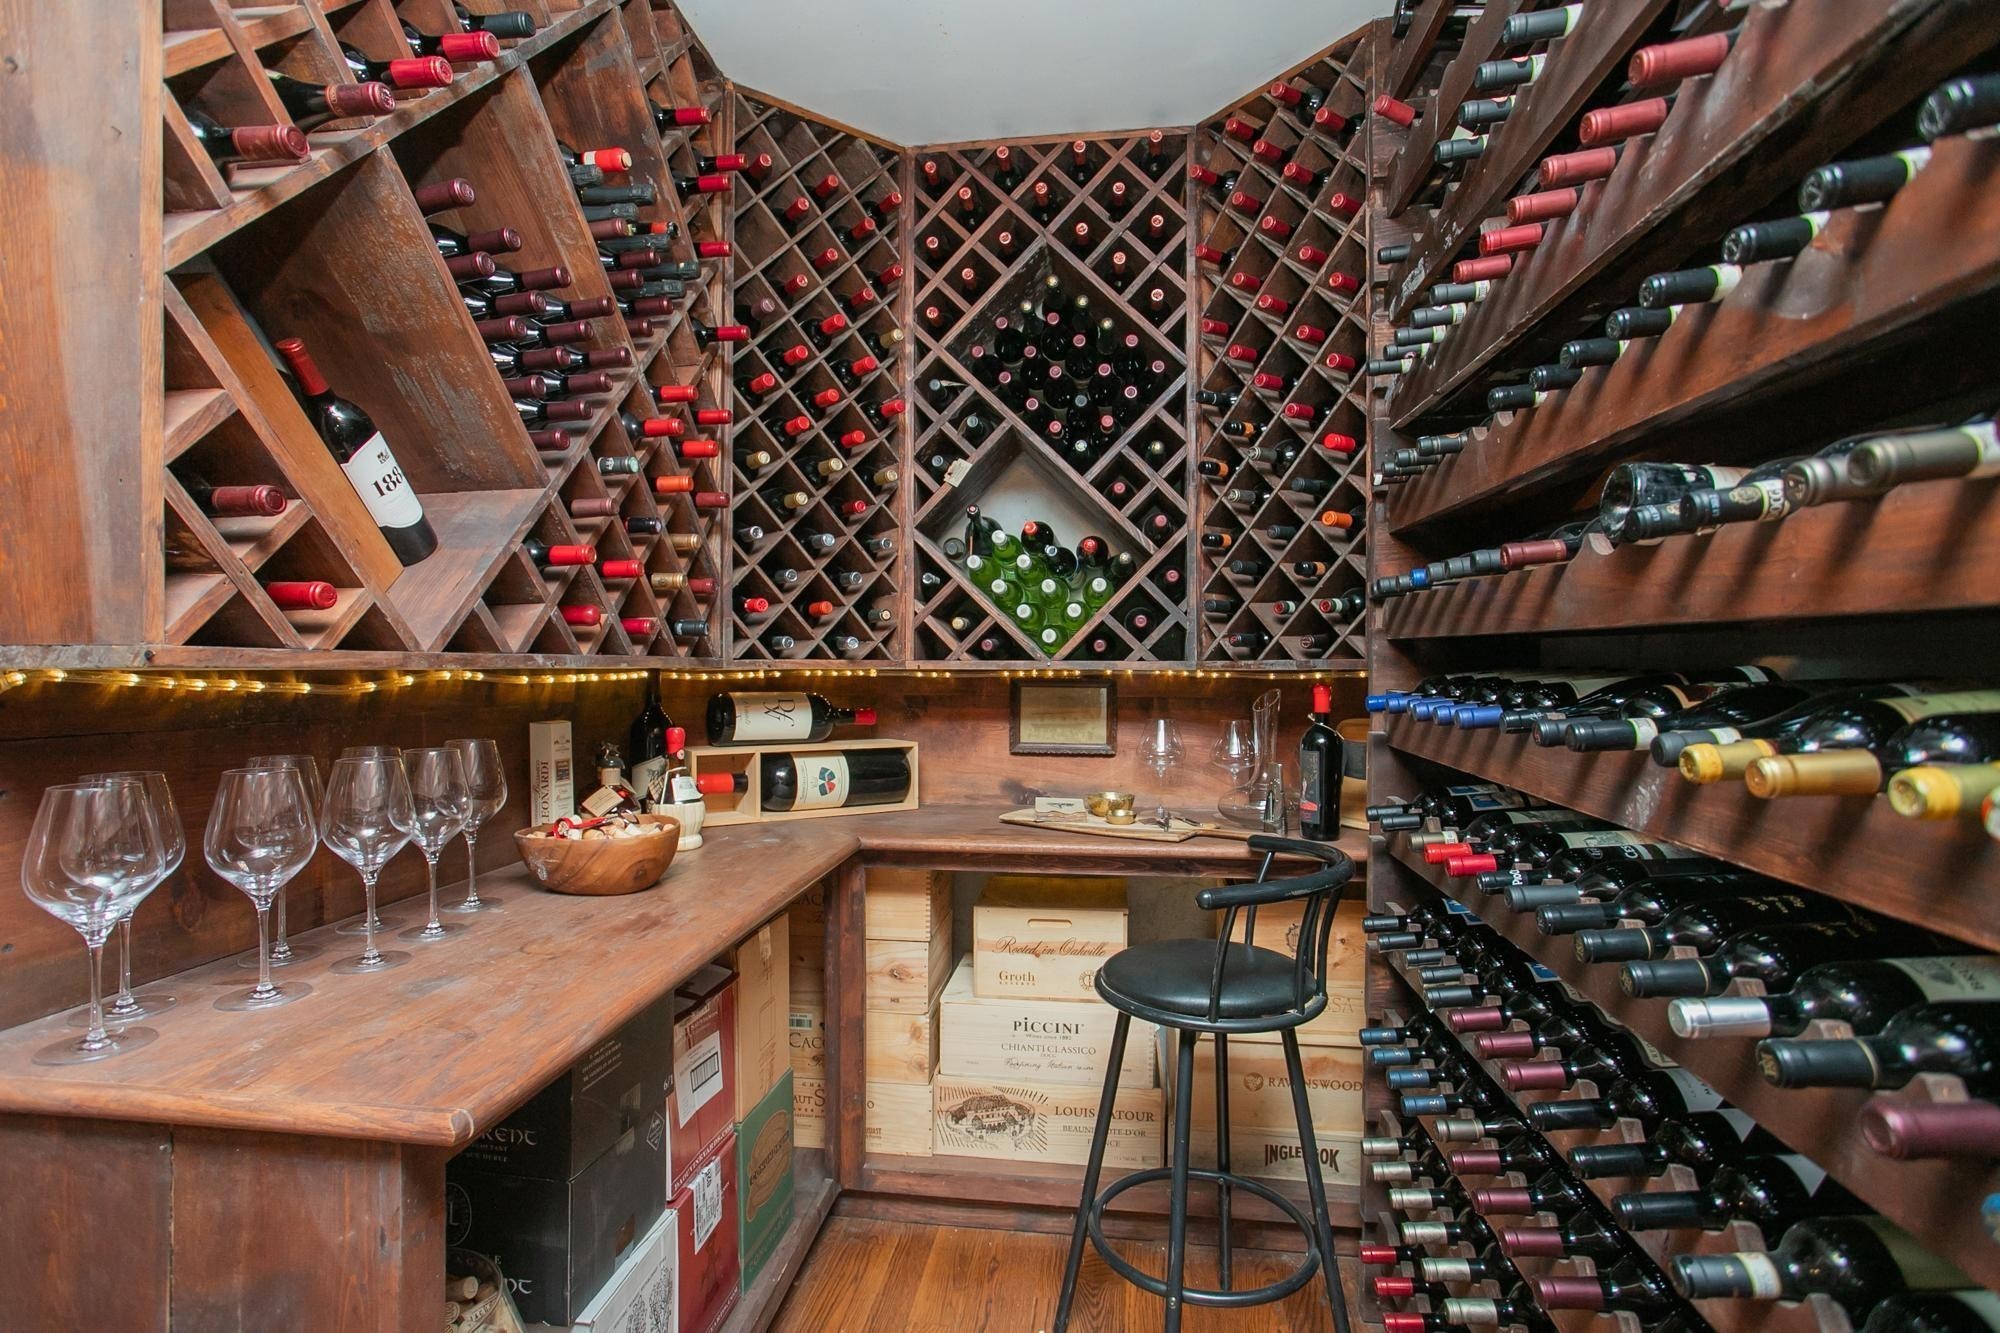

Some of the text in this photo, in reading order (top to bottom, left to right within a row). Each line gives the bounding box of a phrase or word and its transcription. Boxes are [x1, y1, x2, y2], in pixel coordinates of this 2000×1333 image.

[992, 935, 1109, 957] Rooted in Oakville
[999, 970, 1035, 982] Groth
[789, 1031, 825, 1049] CAC
[1001, 1042, 1097, 1056] CHIANTI CLASSICO
[1268, 1077, 1363, 1092] RAVNSWOOD
[793, 1095, 813, 1105] AUT
[1055, 1105, 1155, 1122] LOUIS ATOUR
[1264, 1144, 1340, 1173] INGLEOK
